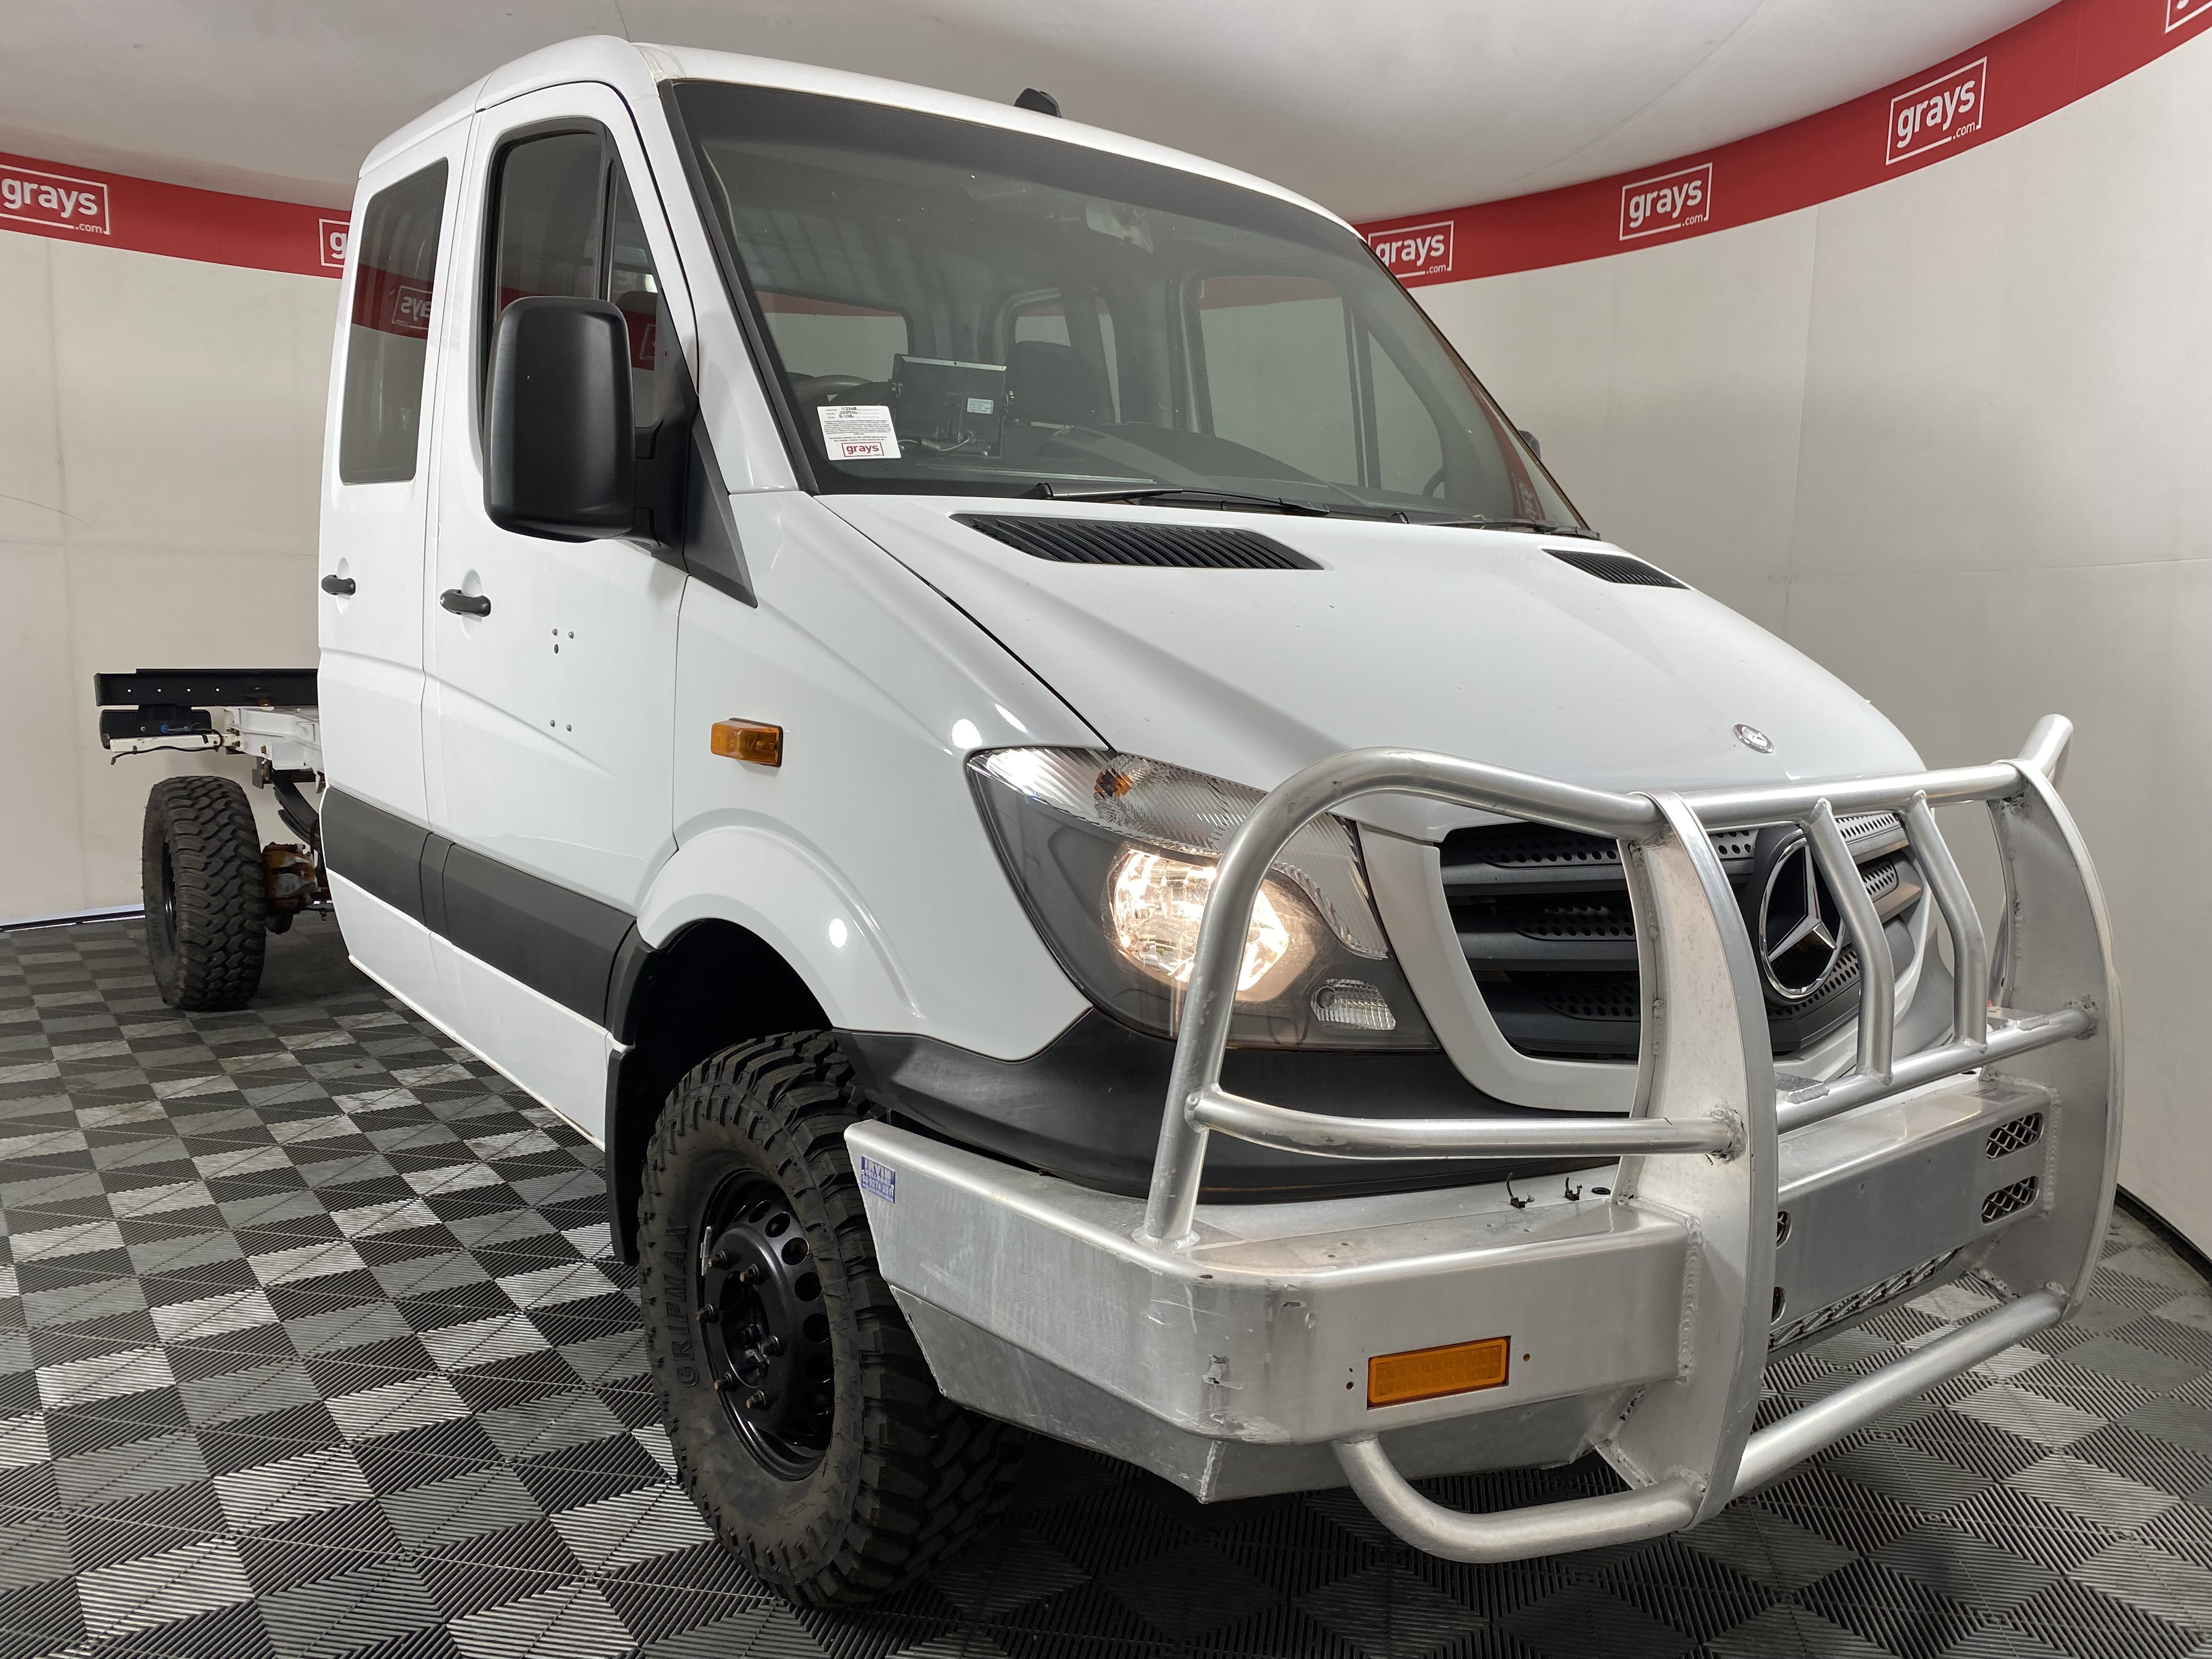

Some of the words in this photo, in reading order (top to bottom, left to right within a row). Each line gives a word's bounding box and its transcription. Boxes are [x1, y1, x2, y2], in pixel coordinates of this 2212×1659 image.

[1897, 80, 1976, 149] grays
[1953, 122, 1976, 139] .com
[2, 178, 98, 218] grays
[1629, 180, 1702, 228] grays
[75, 223, 103, 234] .com
[1682, 214, 1703, 227] .com
[1375, 235, 1445, 267] grays
[1426, 264, 1447, 274] .com
[847, 445, 879, 454] grays
